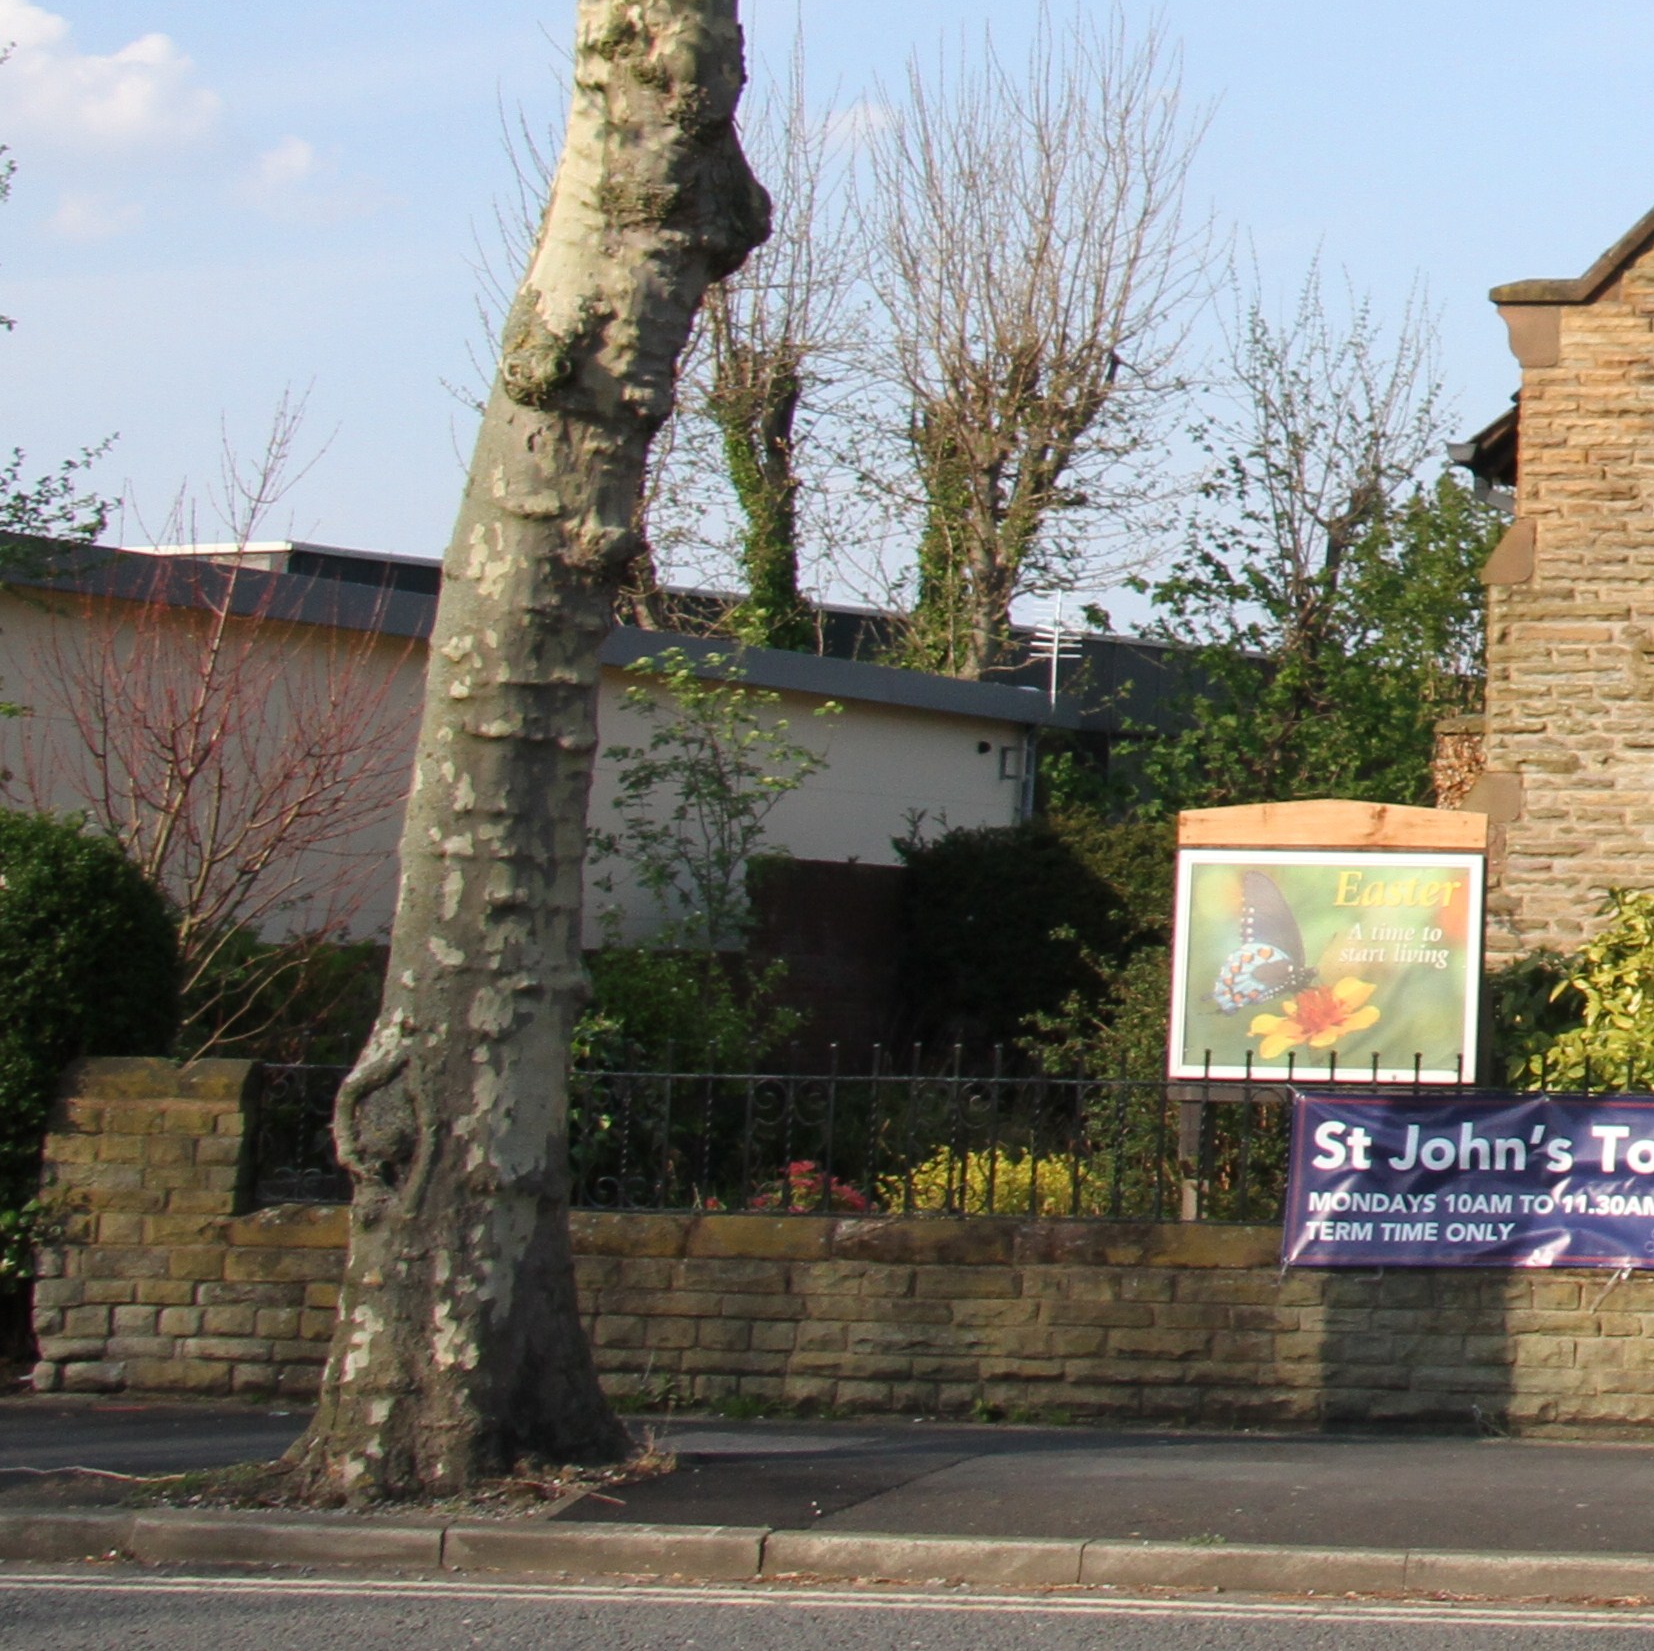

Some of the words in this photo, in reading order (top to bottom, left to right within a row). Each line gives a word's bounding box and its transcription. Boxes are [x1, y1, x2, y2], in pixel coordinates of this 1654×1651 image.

[1332, 870, 1462, 908] Easter
[1347, 922, 1362, 941] A
[1371, 923, 1416, 941] time
[1421, 925, 1443, 942] to
[1340, 946, 1386, 962] start
[1393, 943, 1450, 969] living
[1312, 1120, 1372, 1170] St
[1388, 1122, 1574, 1173] John's
[1307, 1191, 1437, 1214] MONDAYS
[1444, 1194, 1513, 1214] 10AM
[1519, 1195, 1554, 1215] TO
[1305, 1221, 1373, 1242] TERM
[1380, 1222, 1438, 1242] TIME
[1445, 1222, 1516, 1242] ONLY
